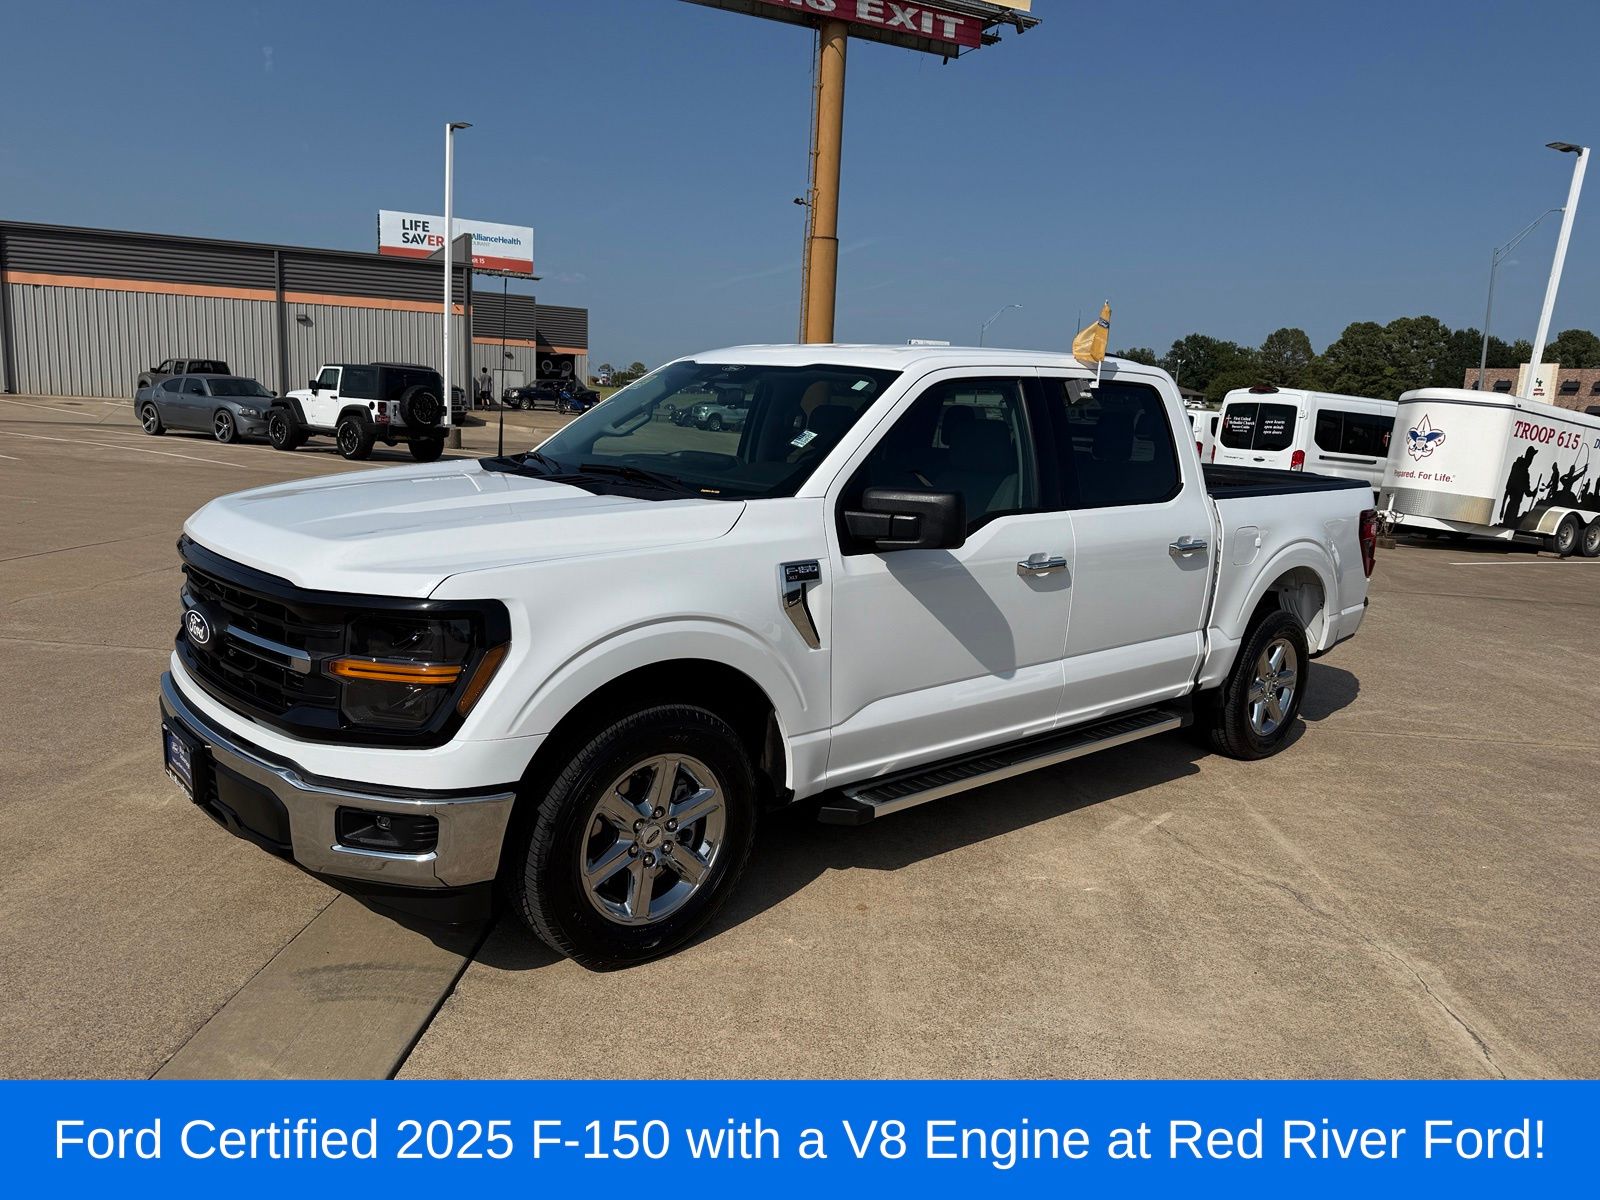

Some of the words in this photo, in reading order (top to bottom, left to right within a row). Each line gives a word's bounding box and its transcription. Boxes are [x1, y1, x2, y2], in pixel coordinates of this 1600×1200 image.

[856, 0, 965, 39] EXIT
[402, 219, 430, 232] LIFE
[402, 232, 445, 247] SAVER
[472, 232, 521, 246] AllianceHealth
[1513, 420, 1556, 444] TROOP
[1557, 431, 1581, 450] 615
[1418, 471, 1432, 480] For
[1434, 472, 1453, 483] Life.
[786, 565, 817, 574] F-150
[189, 613, 205, 640] Ford
